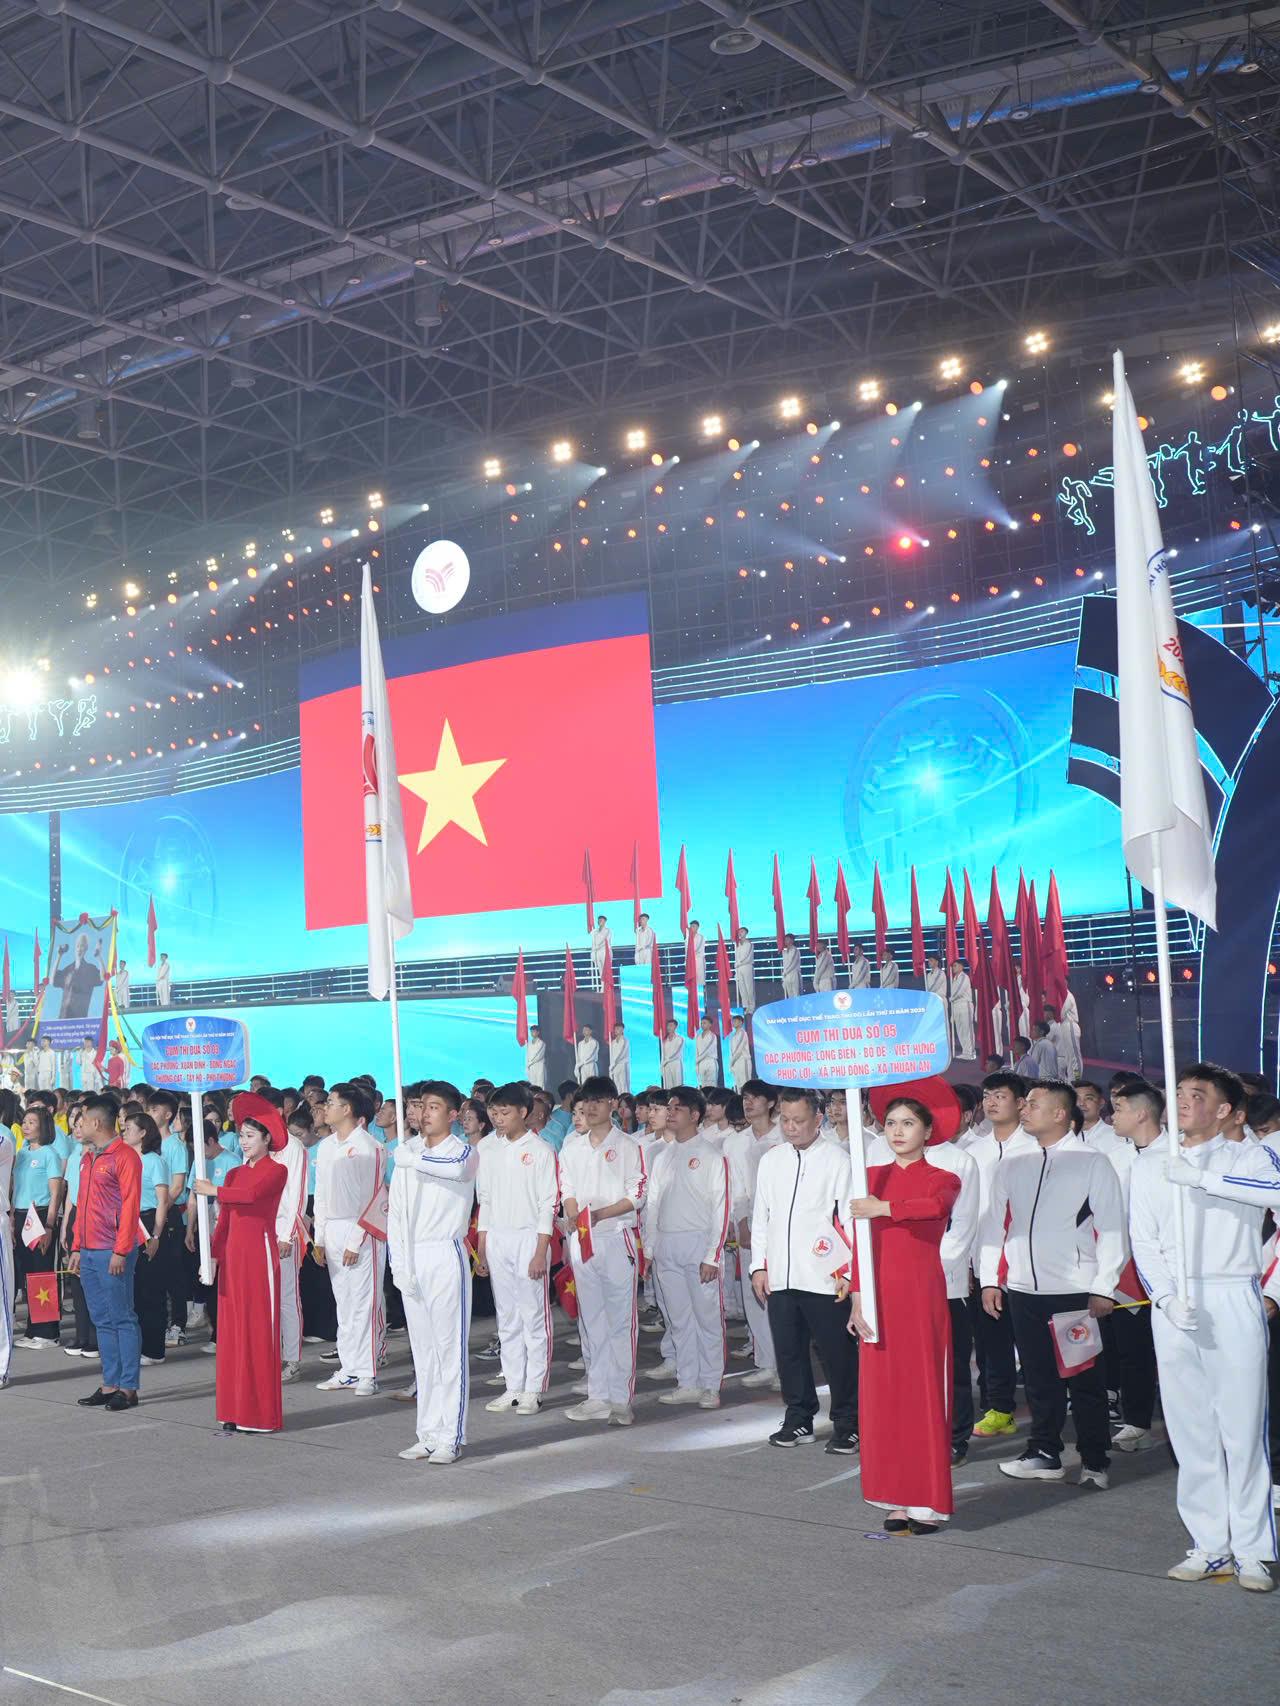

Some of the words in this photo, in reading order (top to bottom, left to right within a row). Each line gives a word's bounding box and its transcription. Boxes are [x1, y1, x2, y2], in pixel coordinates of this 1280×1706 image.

[797, 1029, 820, 1046] CỤM
[823, 1028, 840, 1042] THI
[841, 1026, 863, 1041] ĐUA
[865, 1020, 881, 1039] SỐ
[883, 1023, 897, 1038] 05
[816, 1049, 837, 1061] LONG
